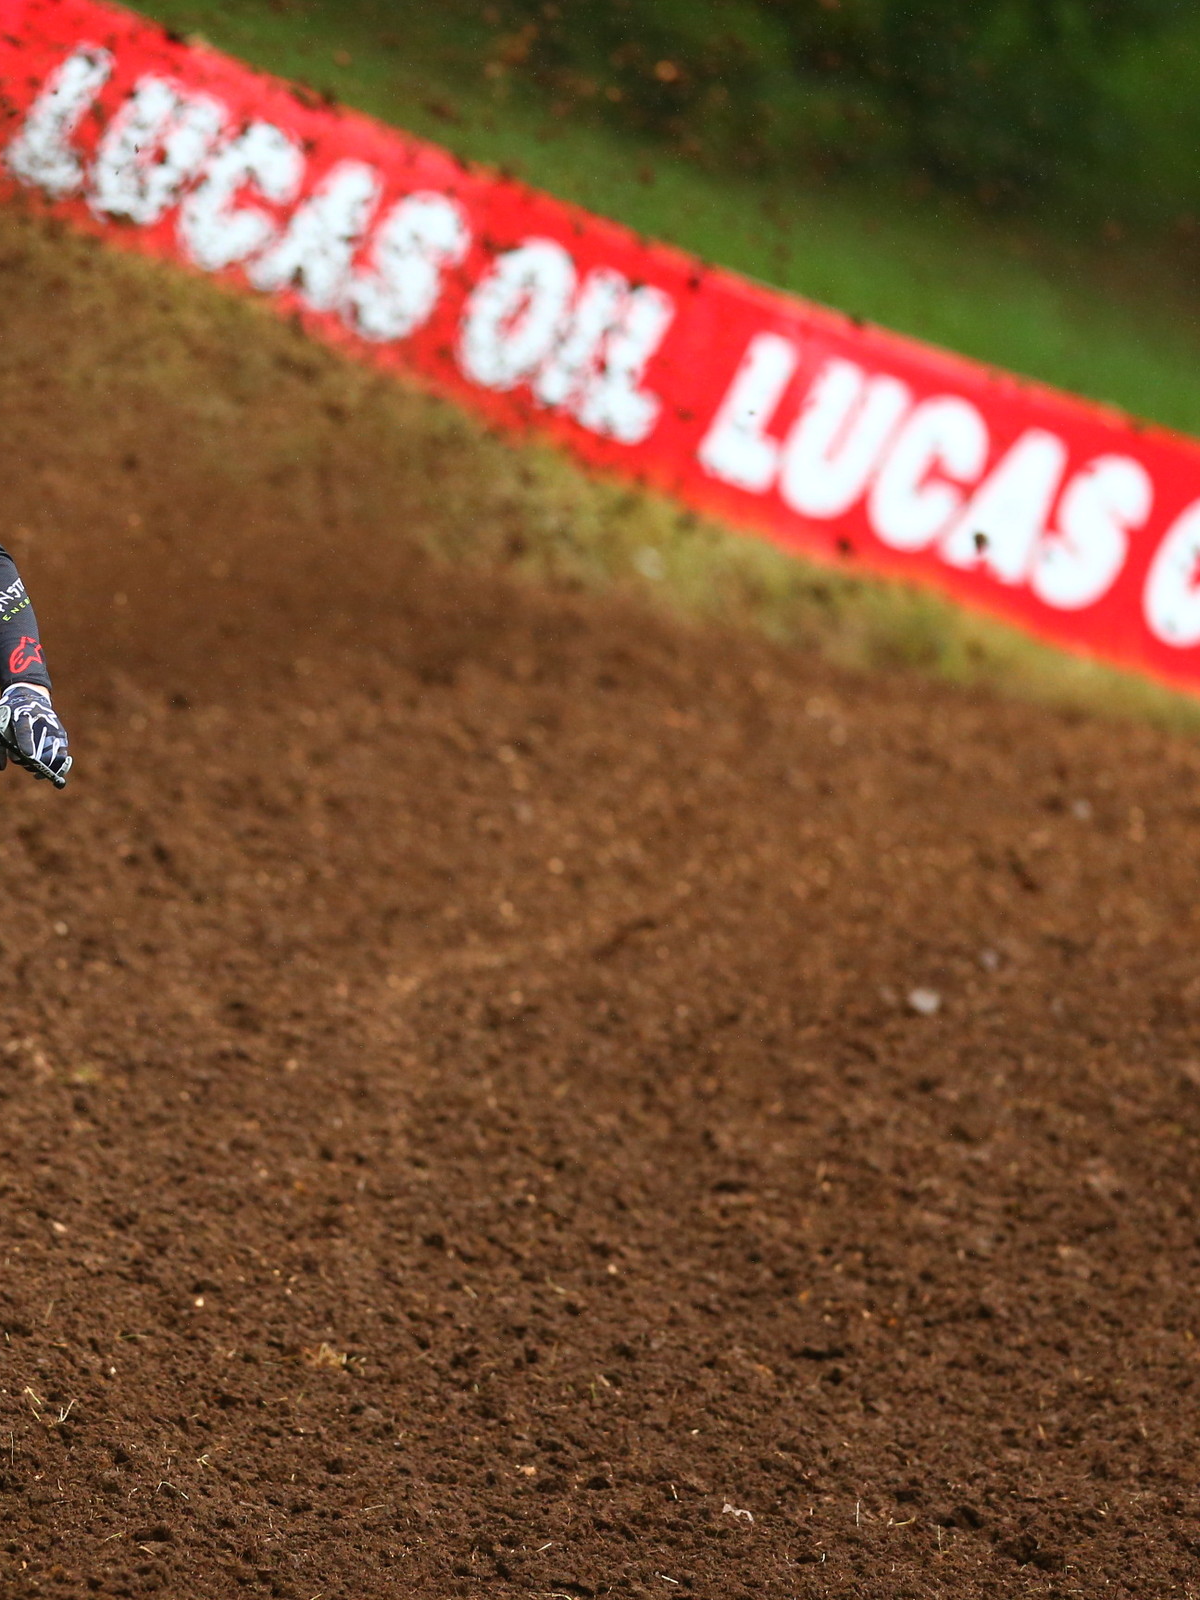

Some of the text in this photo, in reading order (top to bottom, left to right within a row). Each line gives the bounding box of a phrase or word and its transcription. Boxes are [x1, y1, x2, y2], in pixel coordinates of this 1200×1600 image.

[1, 41, 470, 341] LUCAS
[455, 236, 676, 445] OIL
[698, 332, 1153, 611] LUCAS
